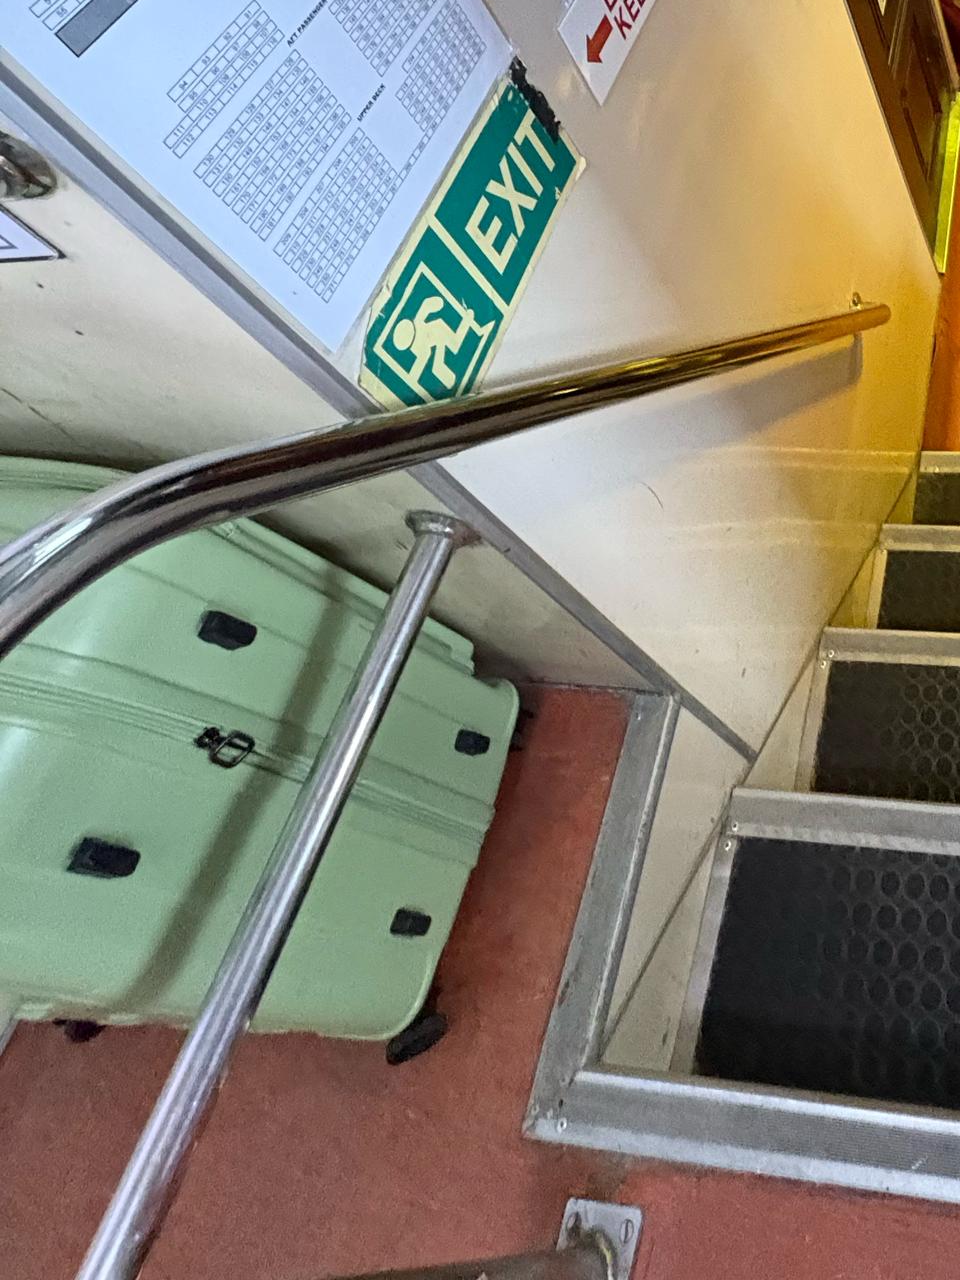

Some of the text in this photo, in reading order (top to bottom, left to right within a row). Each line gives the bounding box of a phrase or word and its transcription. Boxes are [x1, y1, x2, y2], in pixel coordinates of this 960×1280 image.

[287, 30, 299, 47] AFT
[356, 82, 386, 122] UPPER DECK
[464, 108, 556, 276] EXIT
